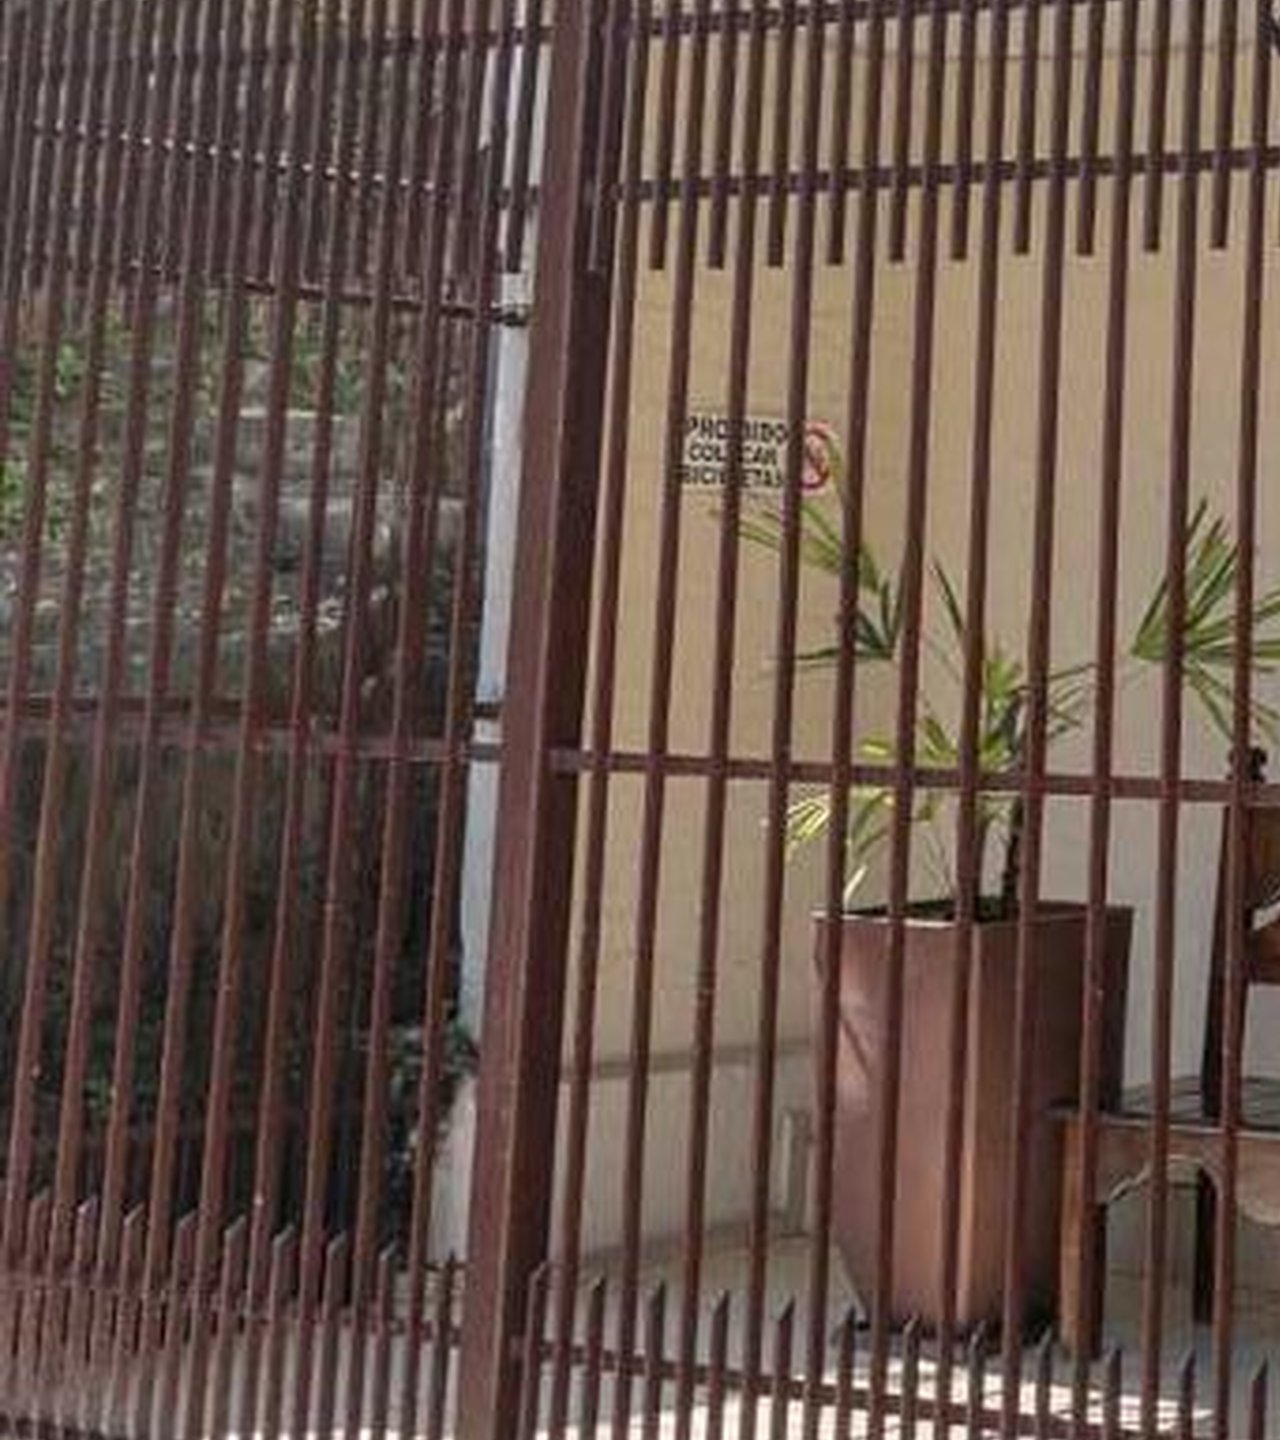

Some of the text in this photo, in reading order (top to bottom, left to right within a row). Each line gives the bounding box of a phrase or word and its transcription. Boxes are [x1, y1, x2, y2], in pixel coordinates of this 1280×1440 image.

[686, 417, 790, 445] PROBIDO
[689, 443, 778, 467] COLCAR
[679, 465, 785, 489] BICIETAS
